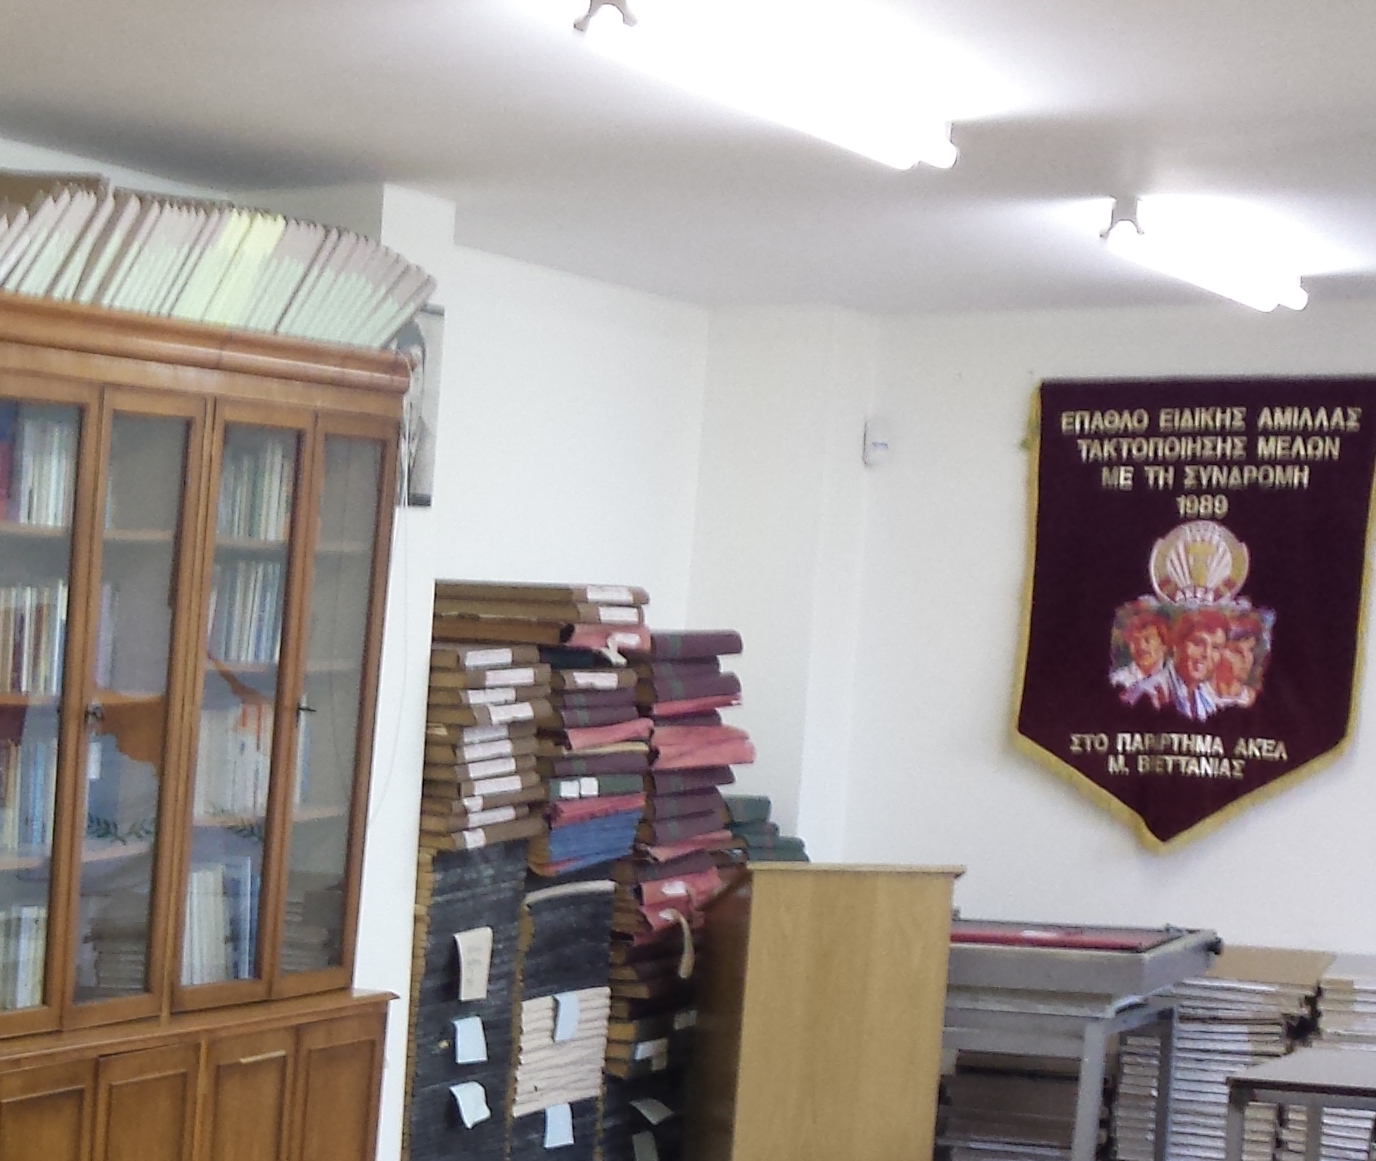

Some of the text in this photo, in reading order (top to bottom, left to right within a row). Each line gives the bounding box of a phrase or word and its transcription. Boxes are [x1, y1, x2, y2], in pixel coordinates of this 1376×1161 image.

[1061, 406, 1362, 434] ΕΠΑΘΛΟ ΕΙΔΙΚΗΣ ΑΜΙΛΛΑΣ
[1077, 436, 1340, 462] ΤΑΚΤΟΠΟΙΗΣΗΣ ΜΕΛΩΝ
[1102, 465, 1310, 490] ΜΕ ΤΗ ΣΥΝΔΡΟΜΗ
[1176, 494, 1229, 519] 1989
[1069, 732, 1288, 761] ΣΤΟ ΠΑΡΡΤΗΜΑ ΑΚΕΛ
[1108, 755, 1246, 779] Μ. ΒΕΤΤΑΝΙΑΣ
